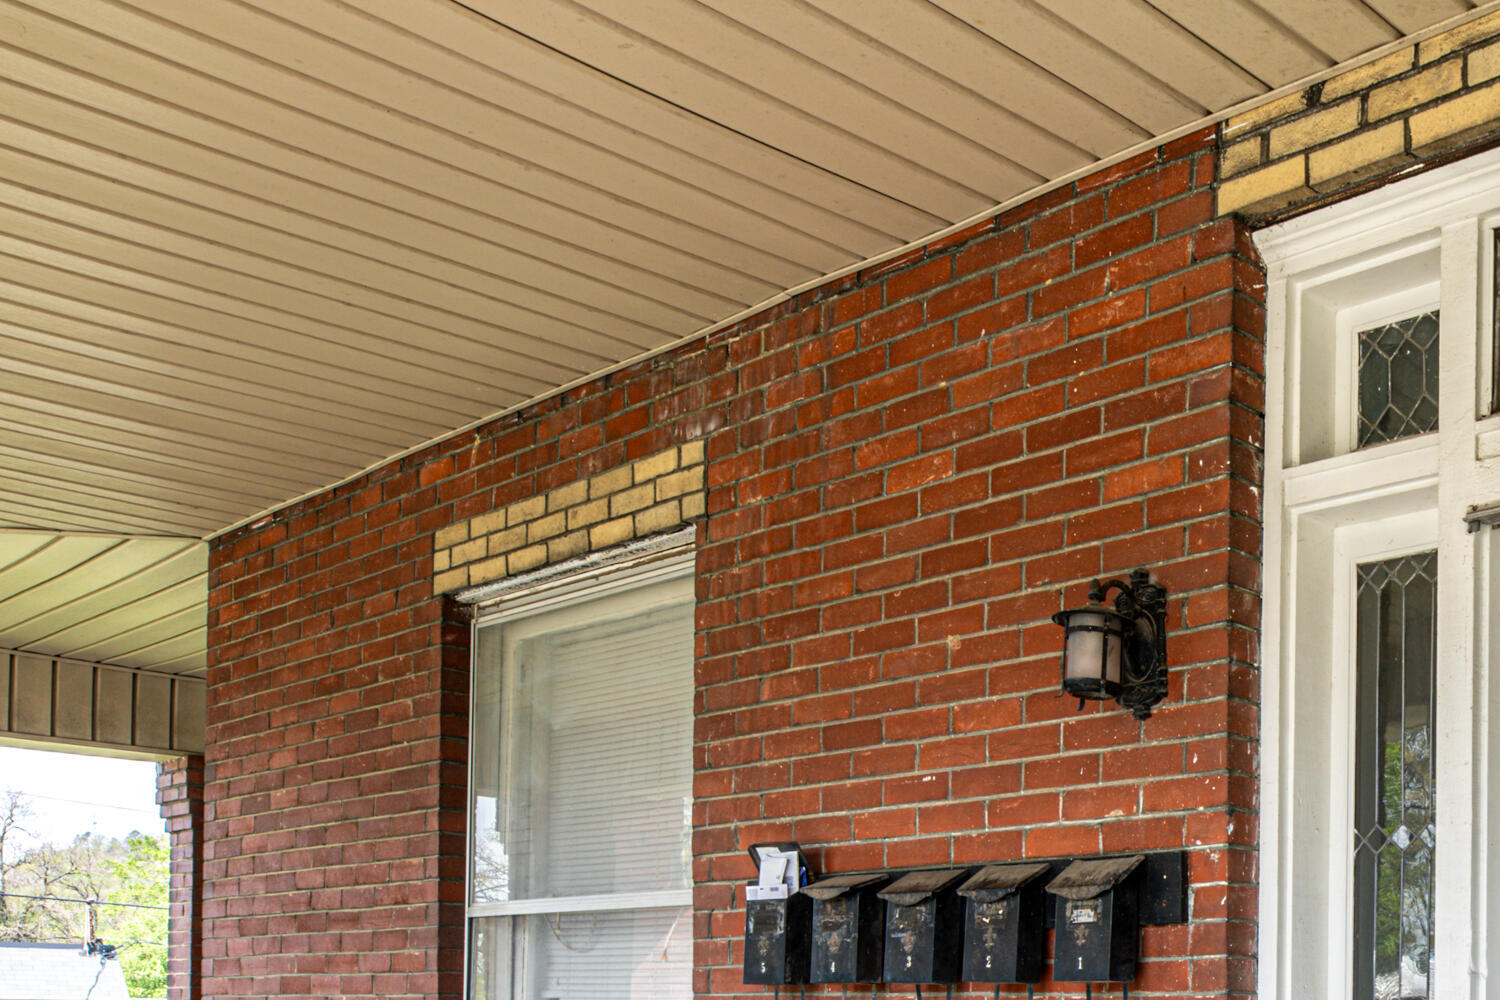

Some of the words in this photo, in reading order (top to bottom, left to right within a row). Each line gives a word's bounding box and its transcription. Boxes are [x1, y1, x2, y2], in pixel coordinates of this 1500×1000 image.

[760, 962, 766, 974] 5
[830, 960, 836, 973] 4
[906, 955, 912, 968] 3
[985, 955, 992, 969] 2
[1077, 956, 1083, 970] 1
